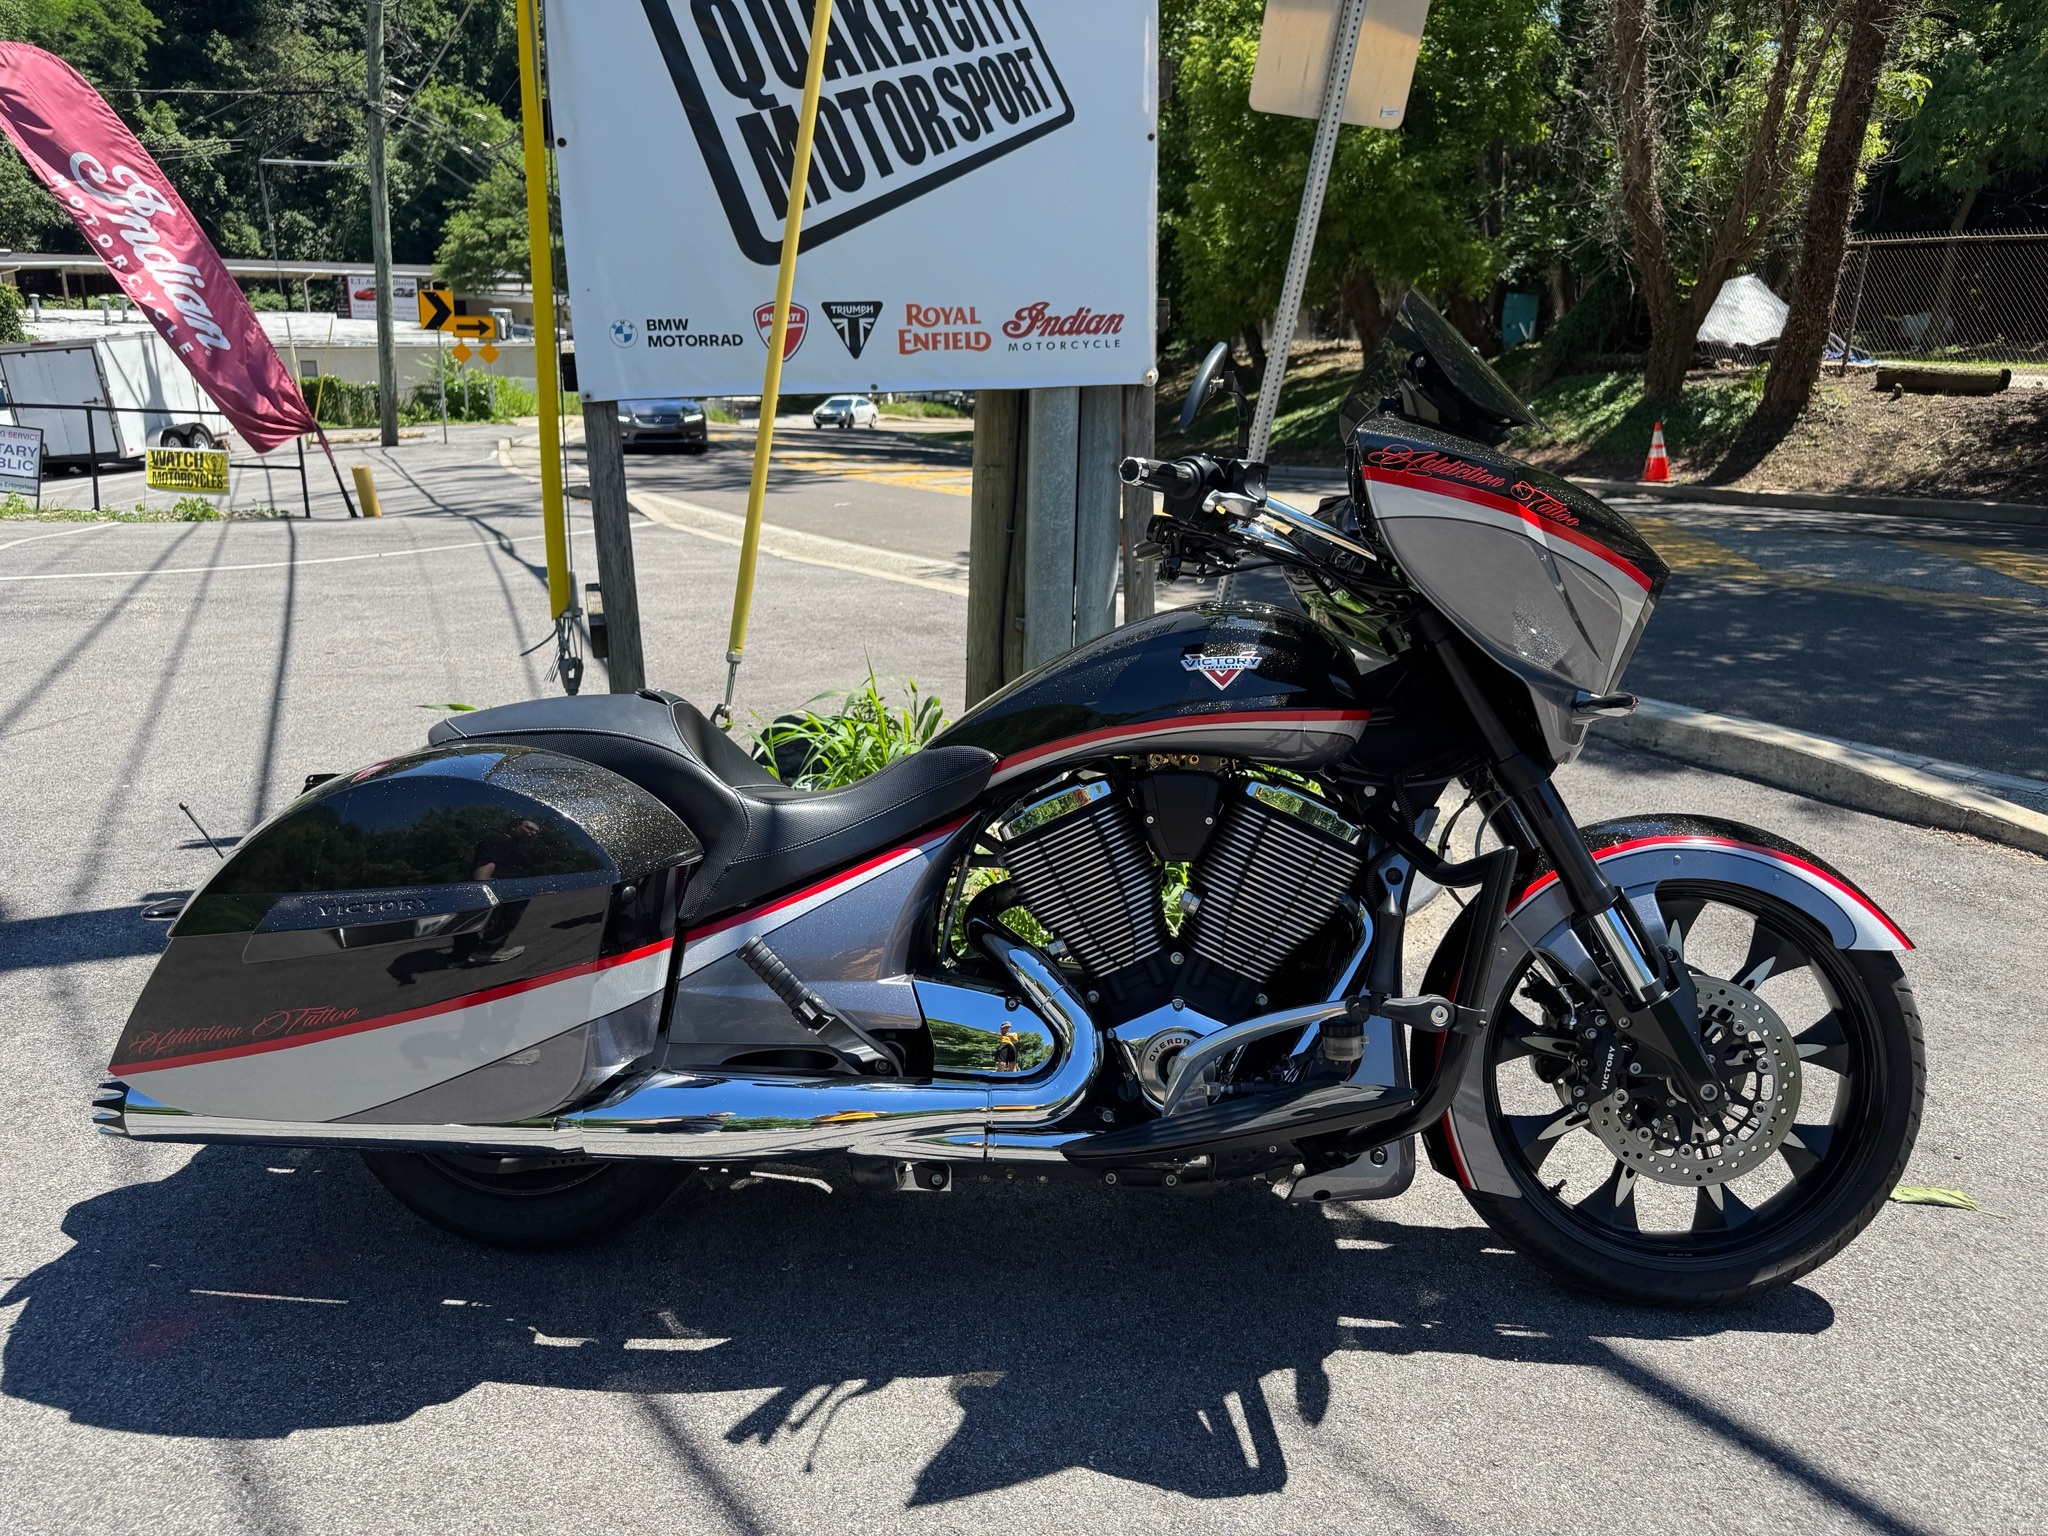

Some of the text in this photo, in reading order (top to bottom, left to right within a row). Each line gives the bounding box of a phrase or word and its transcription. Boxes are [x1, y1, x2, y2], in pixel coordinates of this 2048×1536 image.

[735, 46, 1053, 221] MOTORSPORT
[69, 151, 231, 350] Indian
[51, 173, 195, 355] MOTORCYCLE
[830, 304, 875, 315] TRIUMPH
[905, 303, 982, 328] ROYAL
[1002, 301, 1125, 339] Indian
[646, 318, 689, 331] BMW
[647, 334, 744, 348] MOTORRAD
[898, 329, 992, 355] ENFIELD
[1007, 339, 1121, 352] MOTORCYCLE
[8, 430, 40, 442] SERVICE
[151, 450, 205, 468] WATCH
[152, 471, 223, 489] MOTORCYCLES
[1368, 444, 1580, 527] Addiction Tattoo
[1184, 657, 1260, 668] VICTORY
[318, 897, 436, 916] VICTORY
[252, 1004, 360, 1036] Tattoo
[1149, 1037, 1191, 1062] OVERDR
[1600, 1045, 1616, 1091] VICTORY
